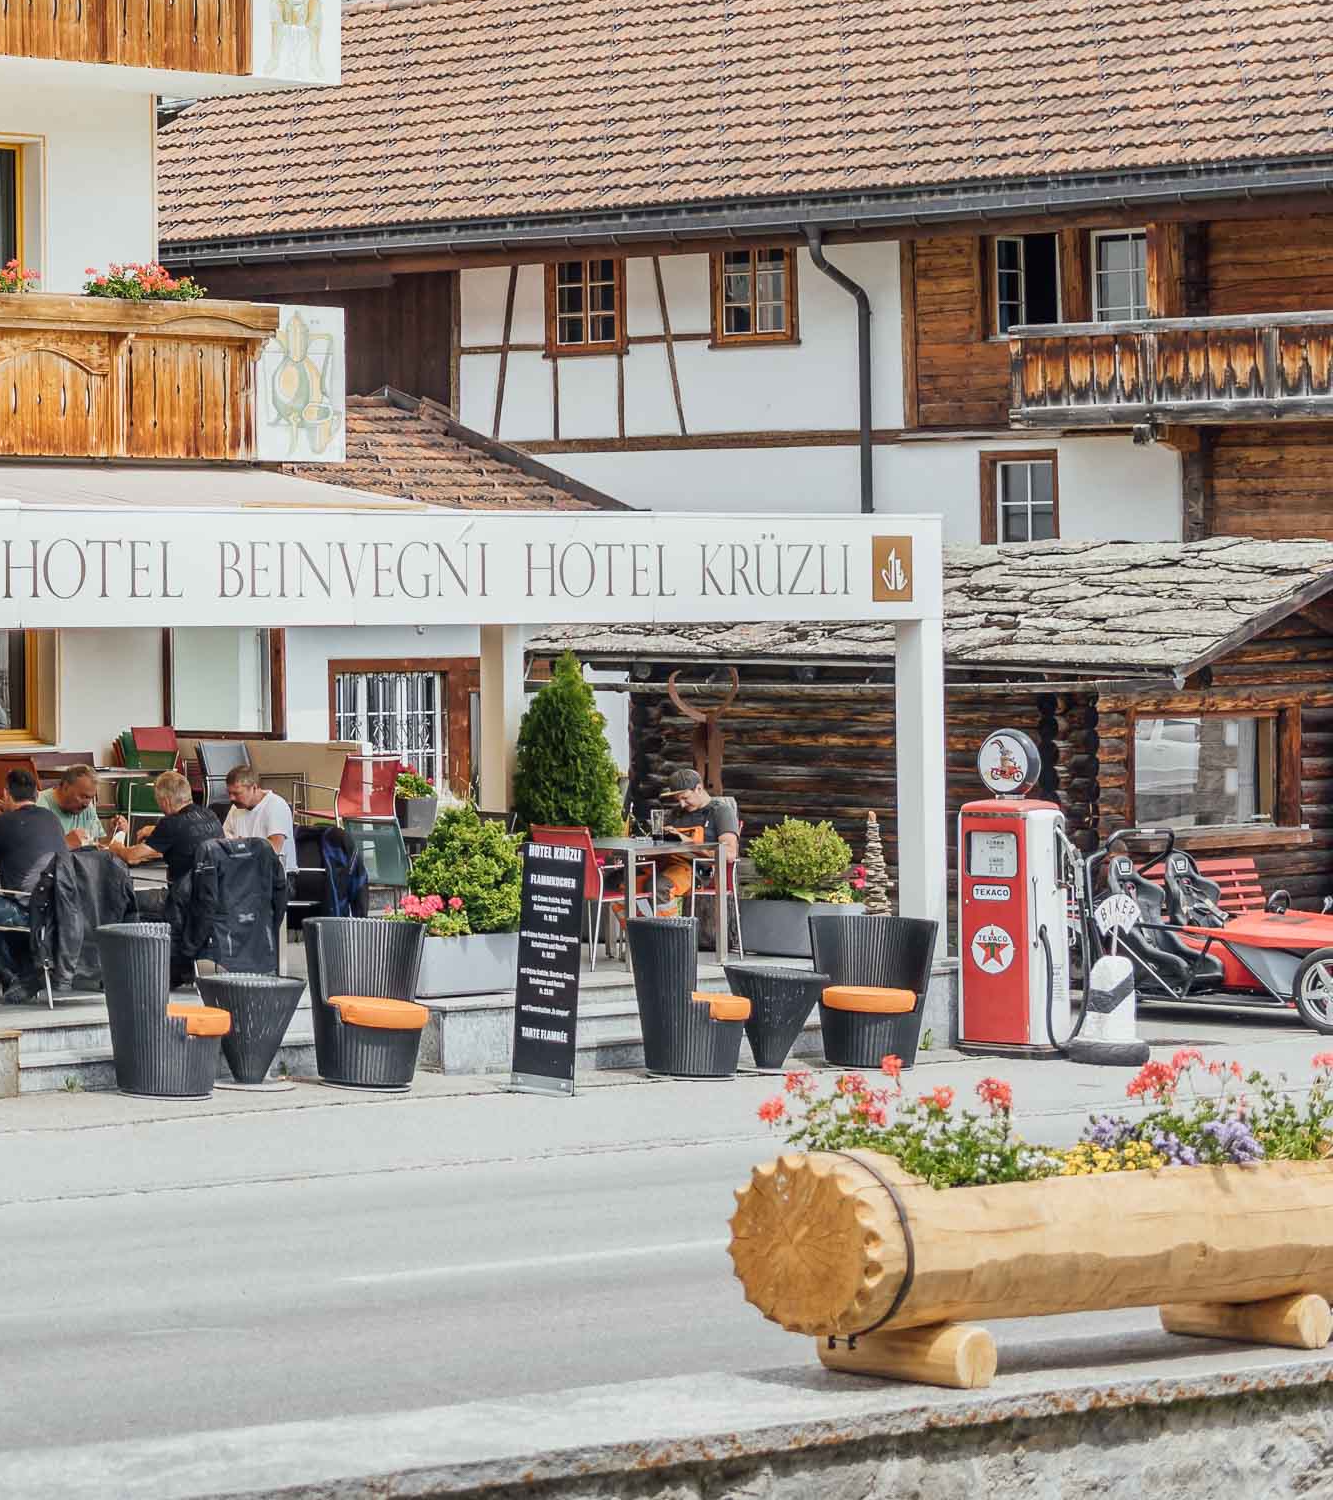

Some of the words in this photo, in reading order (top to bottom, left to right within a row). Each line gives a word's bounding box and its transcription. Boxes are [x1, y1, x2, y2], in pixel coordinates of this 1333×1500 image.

[2, 538, 184, 600] HOTEL
[524, 541, 676, 599] HOTEL
[699, 532, 854, 597] KRÜZLI
[528, 844, 552, 859] HOTEL
[975, 888, 1009, 897] TEXACO
[978, 934, 1008, 942] TEXACO
